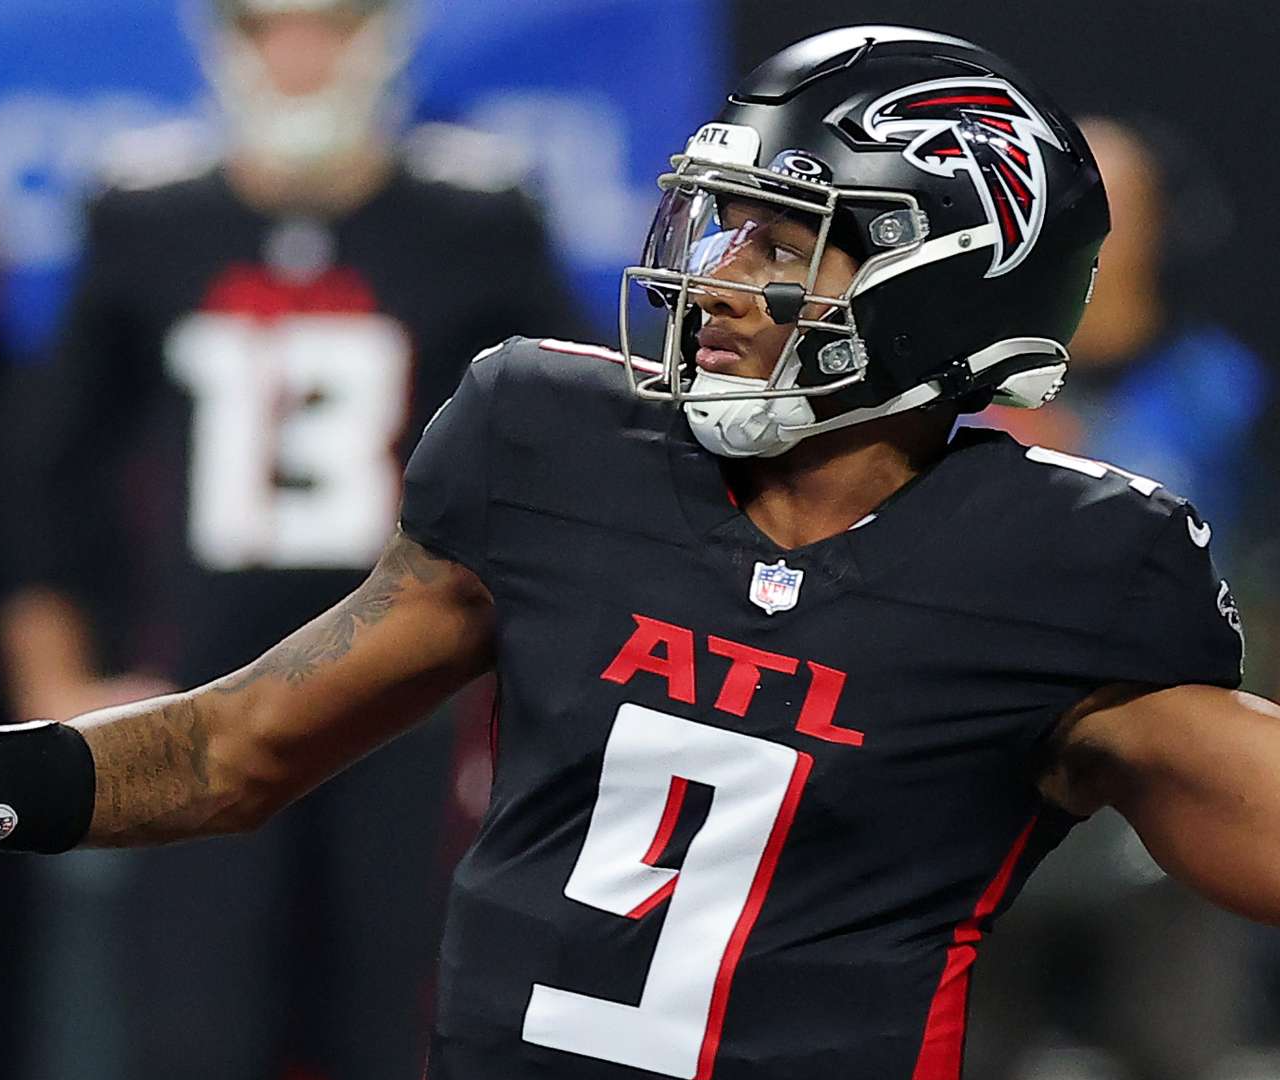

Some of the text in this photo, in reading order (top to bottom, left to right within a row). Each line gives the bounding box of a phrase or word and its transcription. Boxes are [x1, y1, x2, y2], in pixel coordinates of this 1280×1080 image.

[697, 127, 729, 145] ATL
[163, 312, 413, 571] 13
[600, 613, 865, 747] ATL
